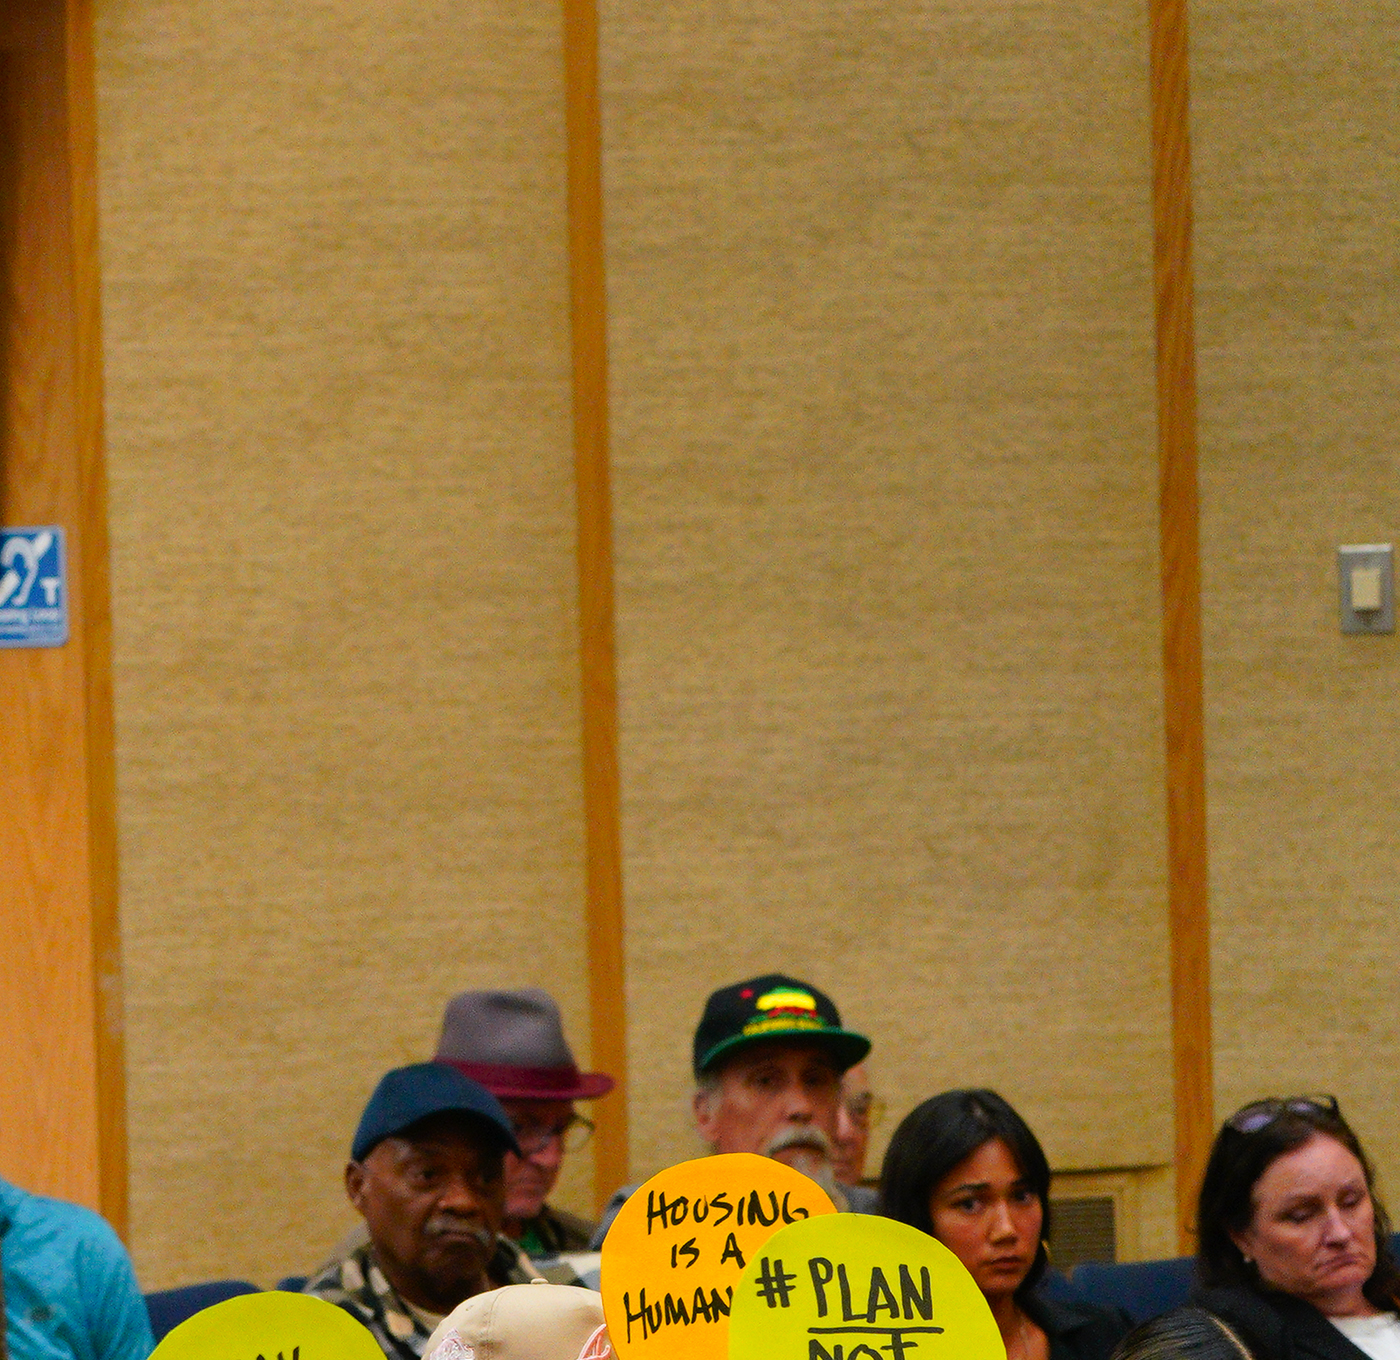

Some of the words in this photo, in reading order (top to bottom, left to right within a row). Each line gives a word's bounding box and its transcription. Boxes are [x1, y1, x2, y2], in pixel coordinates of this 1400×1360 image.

[646, 1190, 809, 1236] HOUSING
[670, 1237, 700, 1269] IS
[720, 1232, 746, 1270] A
[623, 1286, 733, 1344] HUMAN
[755, 1257, 934, 1323] #PLAN
